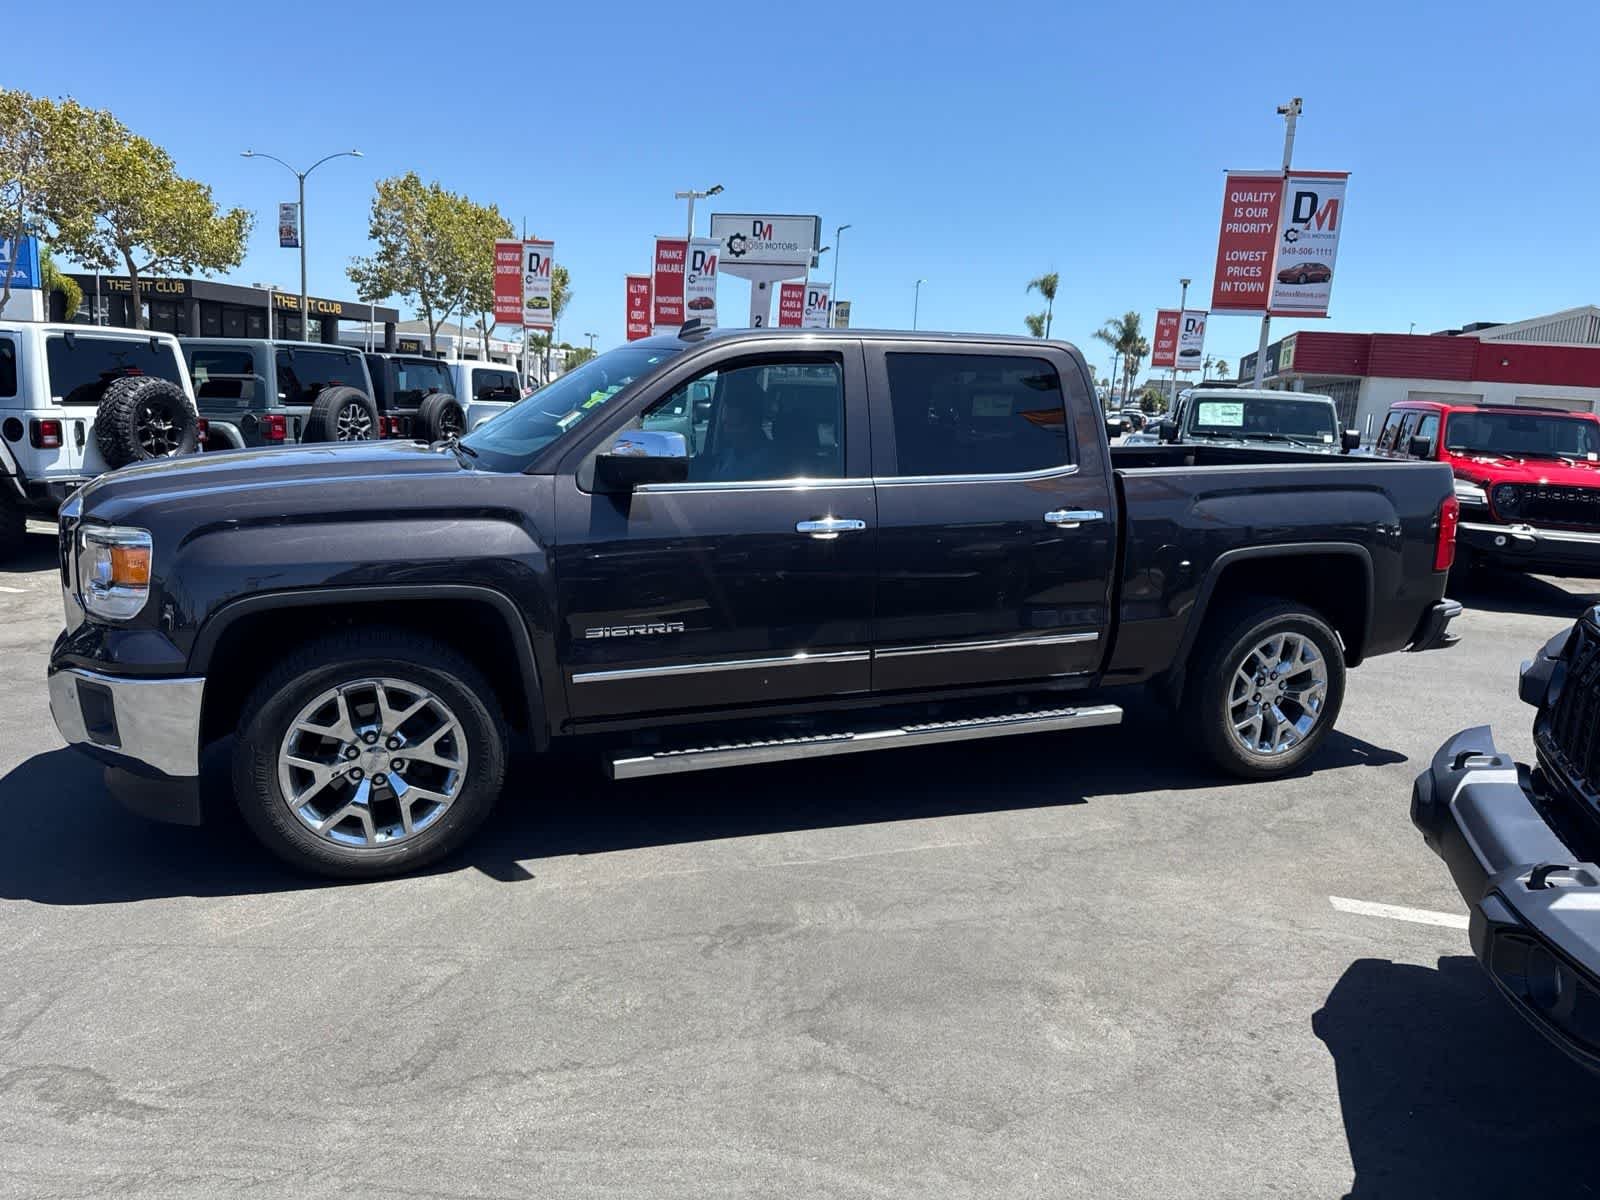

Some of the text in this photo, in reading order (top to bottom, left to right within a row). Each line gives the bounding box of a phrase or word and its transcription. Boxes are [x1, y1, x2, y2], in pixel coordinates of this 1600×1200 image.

[1231, 192, 1276, 203] QUALITY
[1234, 207, 1268, 218] IS OUR
[1292, 191, 1339, 231] DM
[753, 220, 772, 240] DM
[1226, 223, 1273, 234] PRIORITY
[766, 241, 798, 250] MOTORS
[659, 250, 683, 260] FINANCE
[1225, 251, 1267, 262] LOWEST
[1282, 247, 1333, 256] 949-506-1111
[528, 252, 550, 277] DM
[656, 263, 684, 274] AVAILABLE
[692, 250, 717, 276] DM
[1227, 266, 1262, 277] PRICES
[107, 280, 132, 291] THE
[156, 281, 185, 293] CLUB
[1221, 281, 1264, 292] IN TOWN
[274, 295, 297, 308] THE
[318, 301, 342, 314] CLUB
[808, 291, 827, 310] DM
[781, 310, 802, 318] TRUCKS
[755, 315, 762, 328] 2
[585, 621, 685, 639] SIERRA
